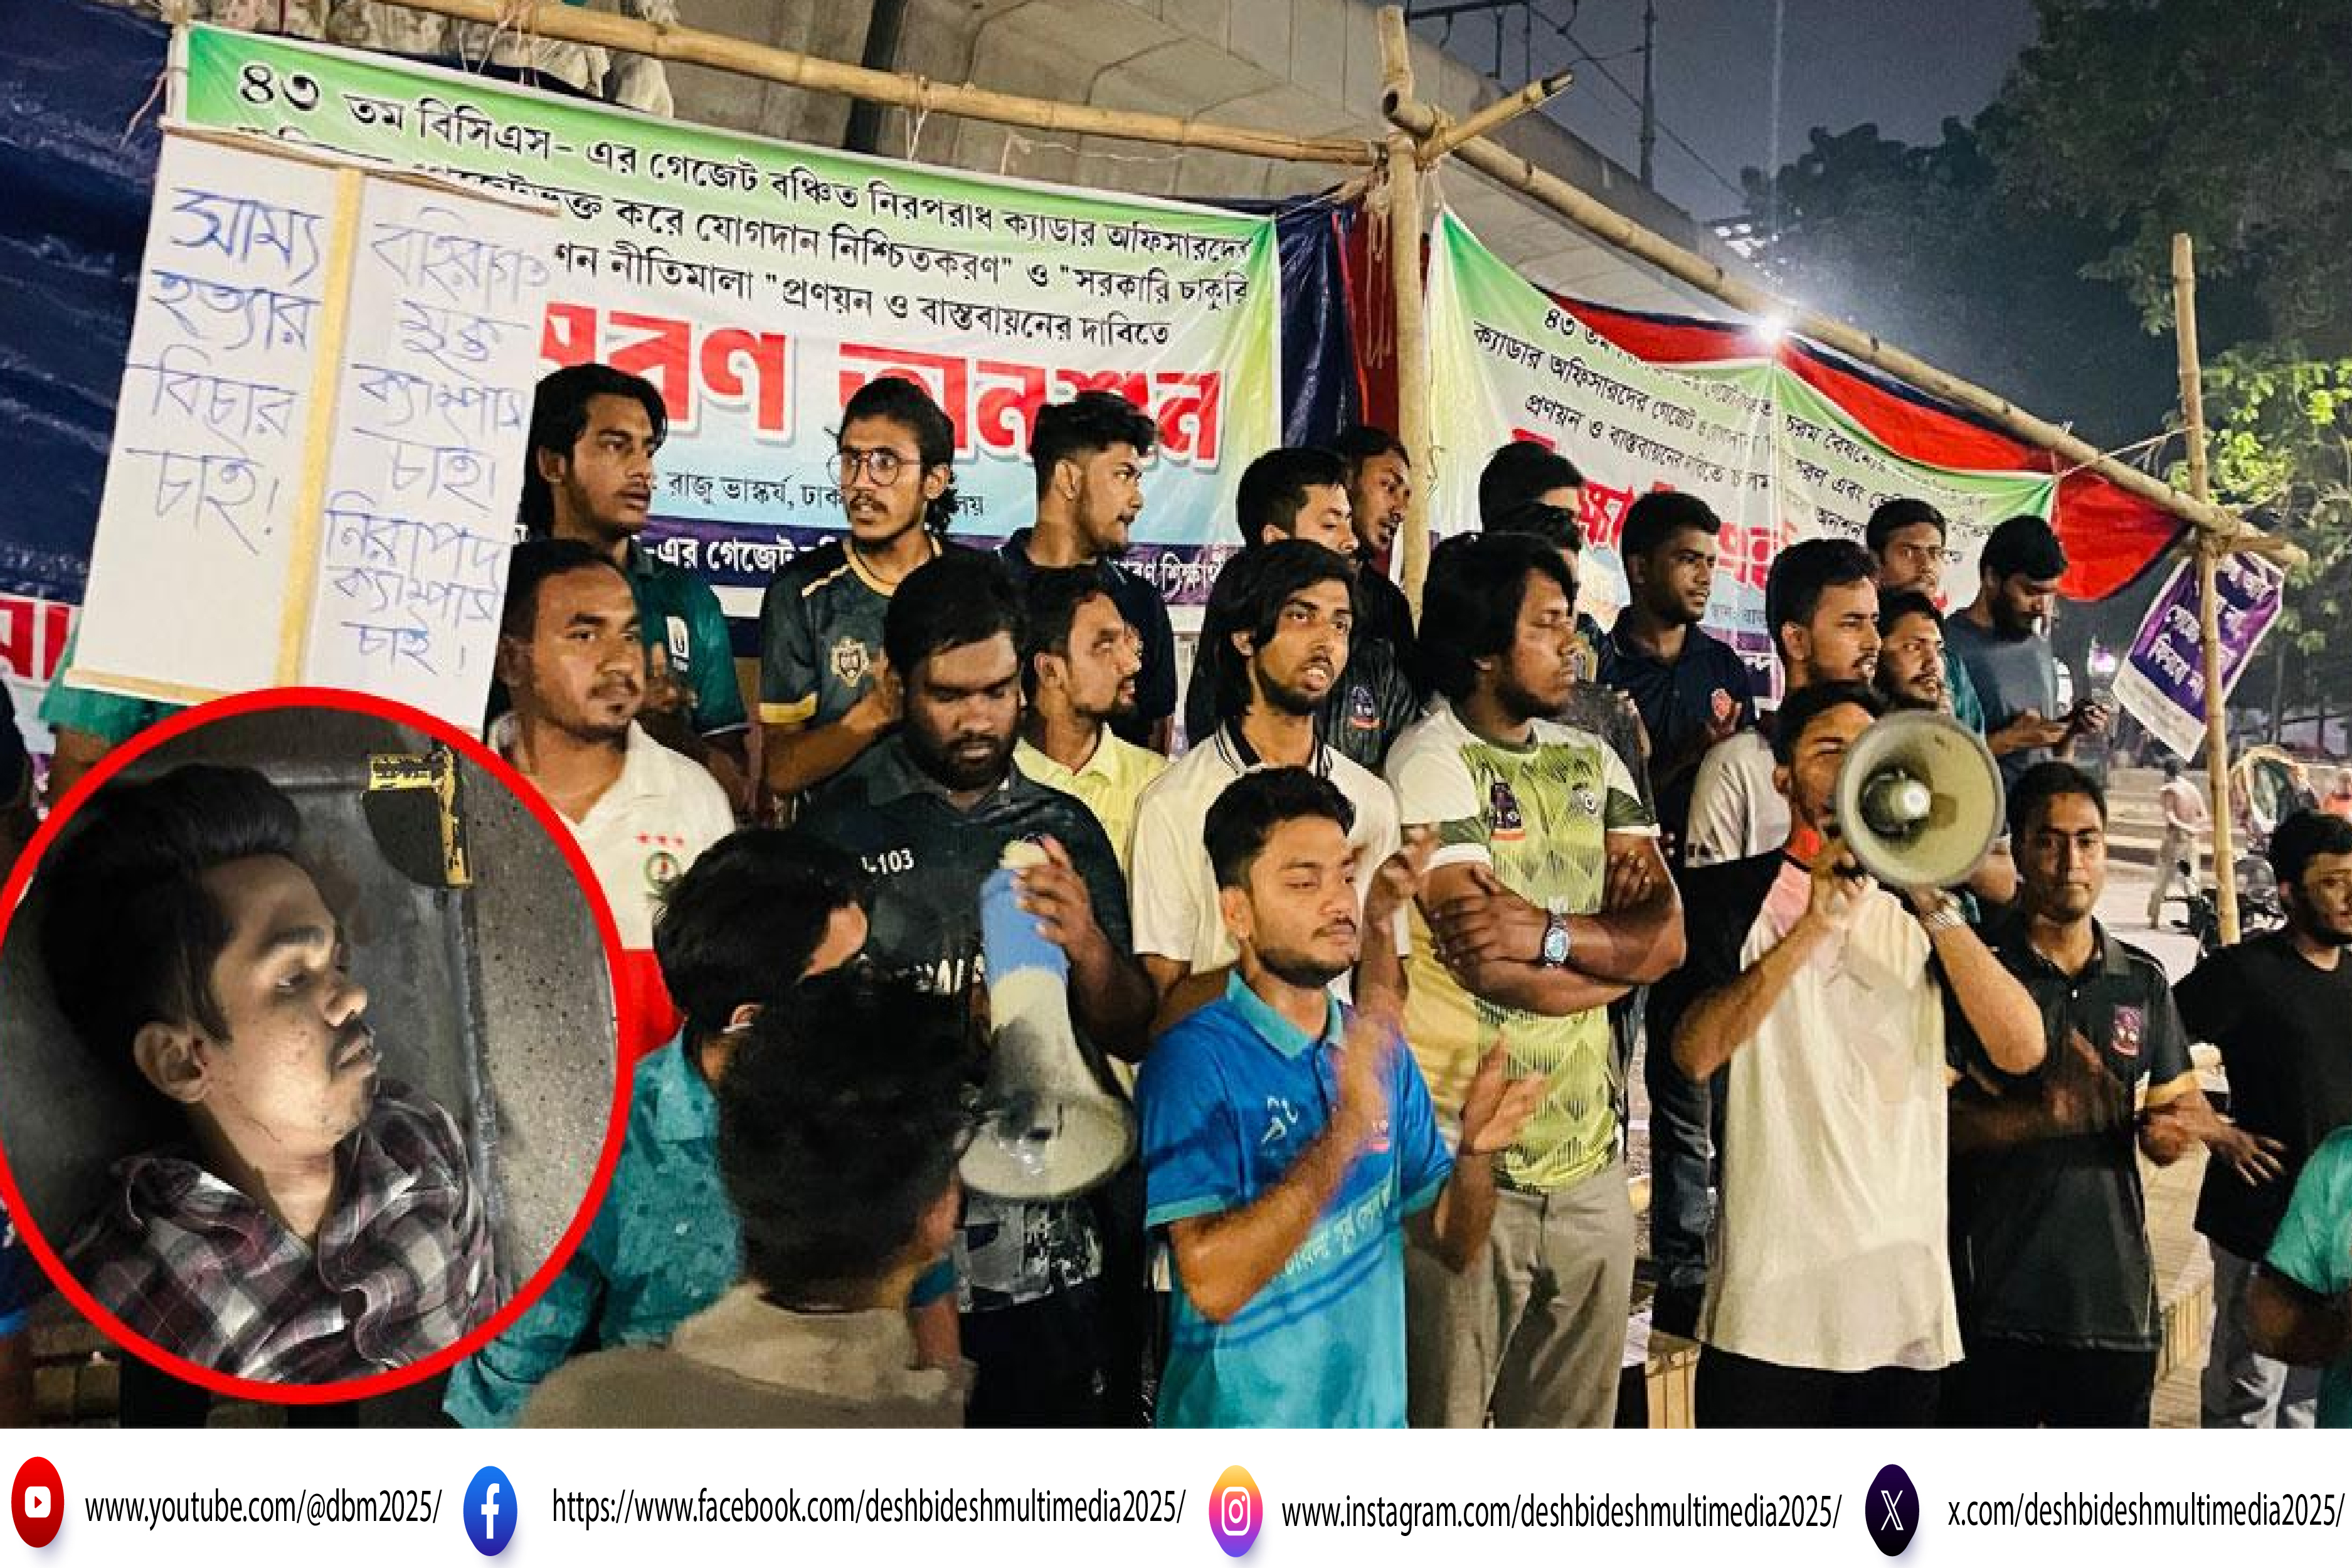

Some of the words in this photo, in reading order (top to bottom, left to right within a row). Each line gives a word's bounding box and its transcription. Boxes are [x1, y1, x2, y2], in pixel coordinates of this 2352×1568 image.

[241, 64, 320, 111] ৪৩
[343, 93, 405, 130] তম
[586, 140, 636, 174] এর
[650, 152, 759, 193] গেজেট
[768, 166, 859, 209] বঞ্চিত
[868, 180, 993, 232] নিরপরাধ
[1000, 209, 1096, 248] ক্যাডার
[613, 197, 684, 235] করে
[696, 213, 821, 259] যোগদান
[1027, 263, 1049, 287] ও
[608, 240, 753, 300] নীতিমালা
[884, 295, 909, 319] ও
[1078, 310, 1173, 346] দাবিতে
[1473, 320, 1545, 369] ক্যাডার
